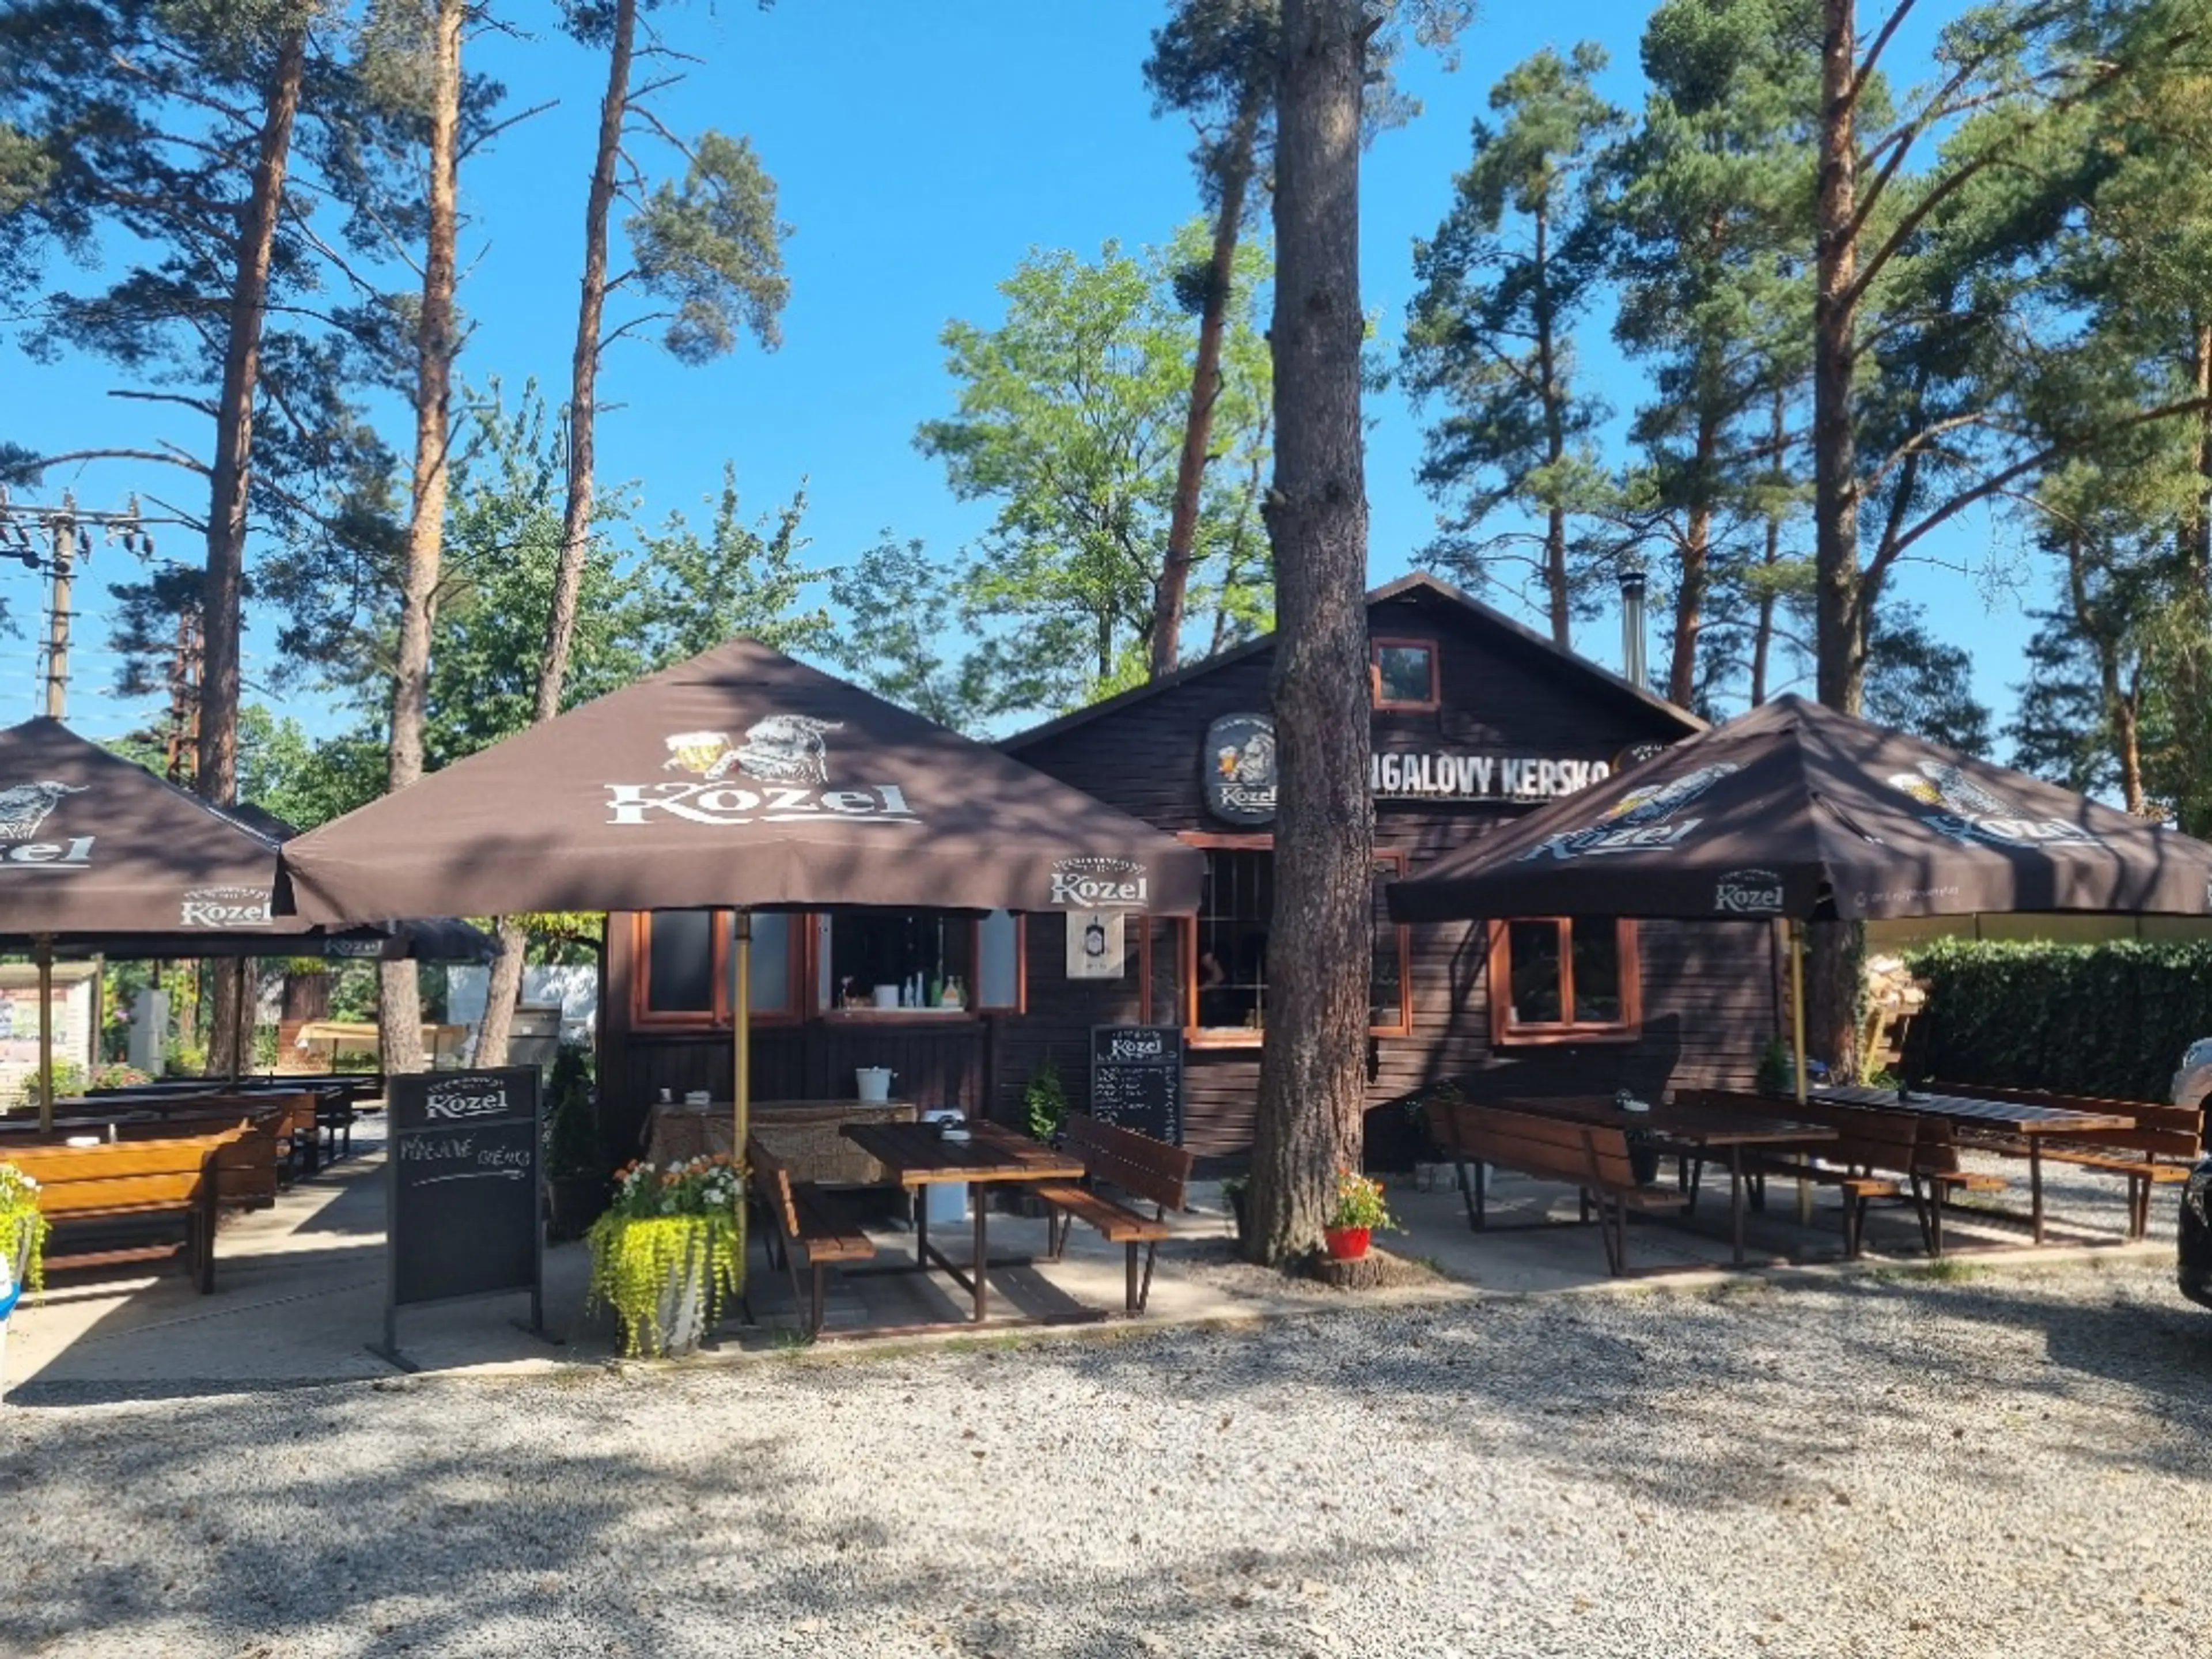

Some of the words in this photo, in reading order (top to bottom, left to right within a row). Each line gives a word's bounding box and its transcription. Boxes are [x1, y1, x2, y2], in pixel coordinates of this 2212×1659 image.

[1502, 758, 1609, 796] KERSKO
[604, 781, 921, 824] Kozel
[1219, 785, 1277, 806] Kozel
[1516, 818, 1704, 861] Kozel
[1922, 813, 2108, 848] Kozel
[1051, 873, 1149, 907] Kozel
[1714, 884, 1783, 912] Kozel
[180, 902, 274, 927] Kozel
[1112, 1039, 1162, 1058] Kozel
[425, 1090, 509, 1119] Kozel
